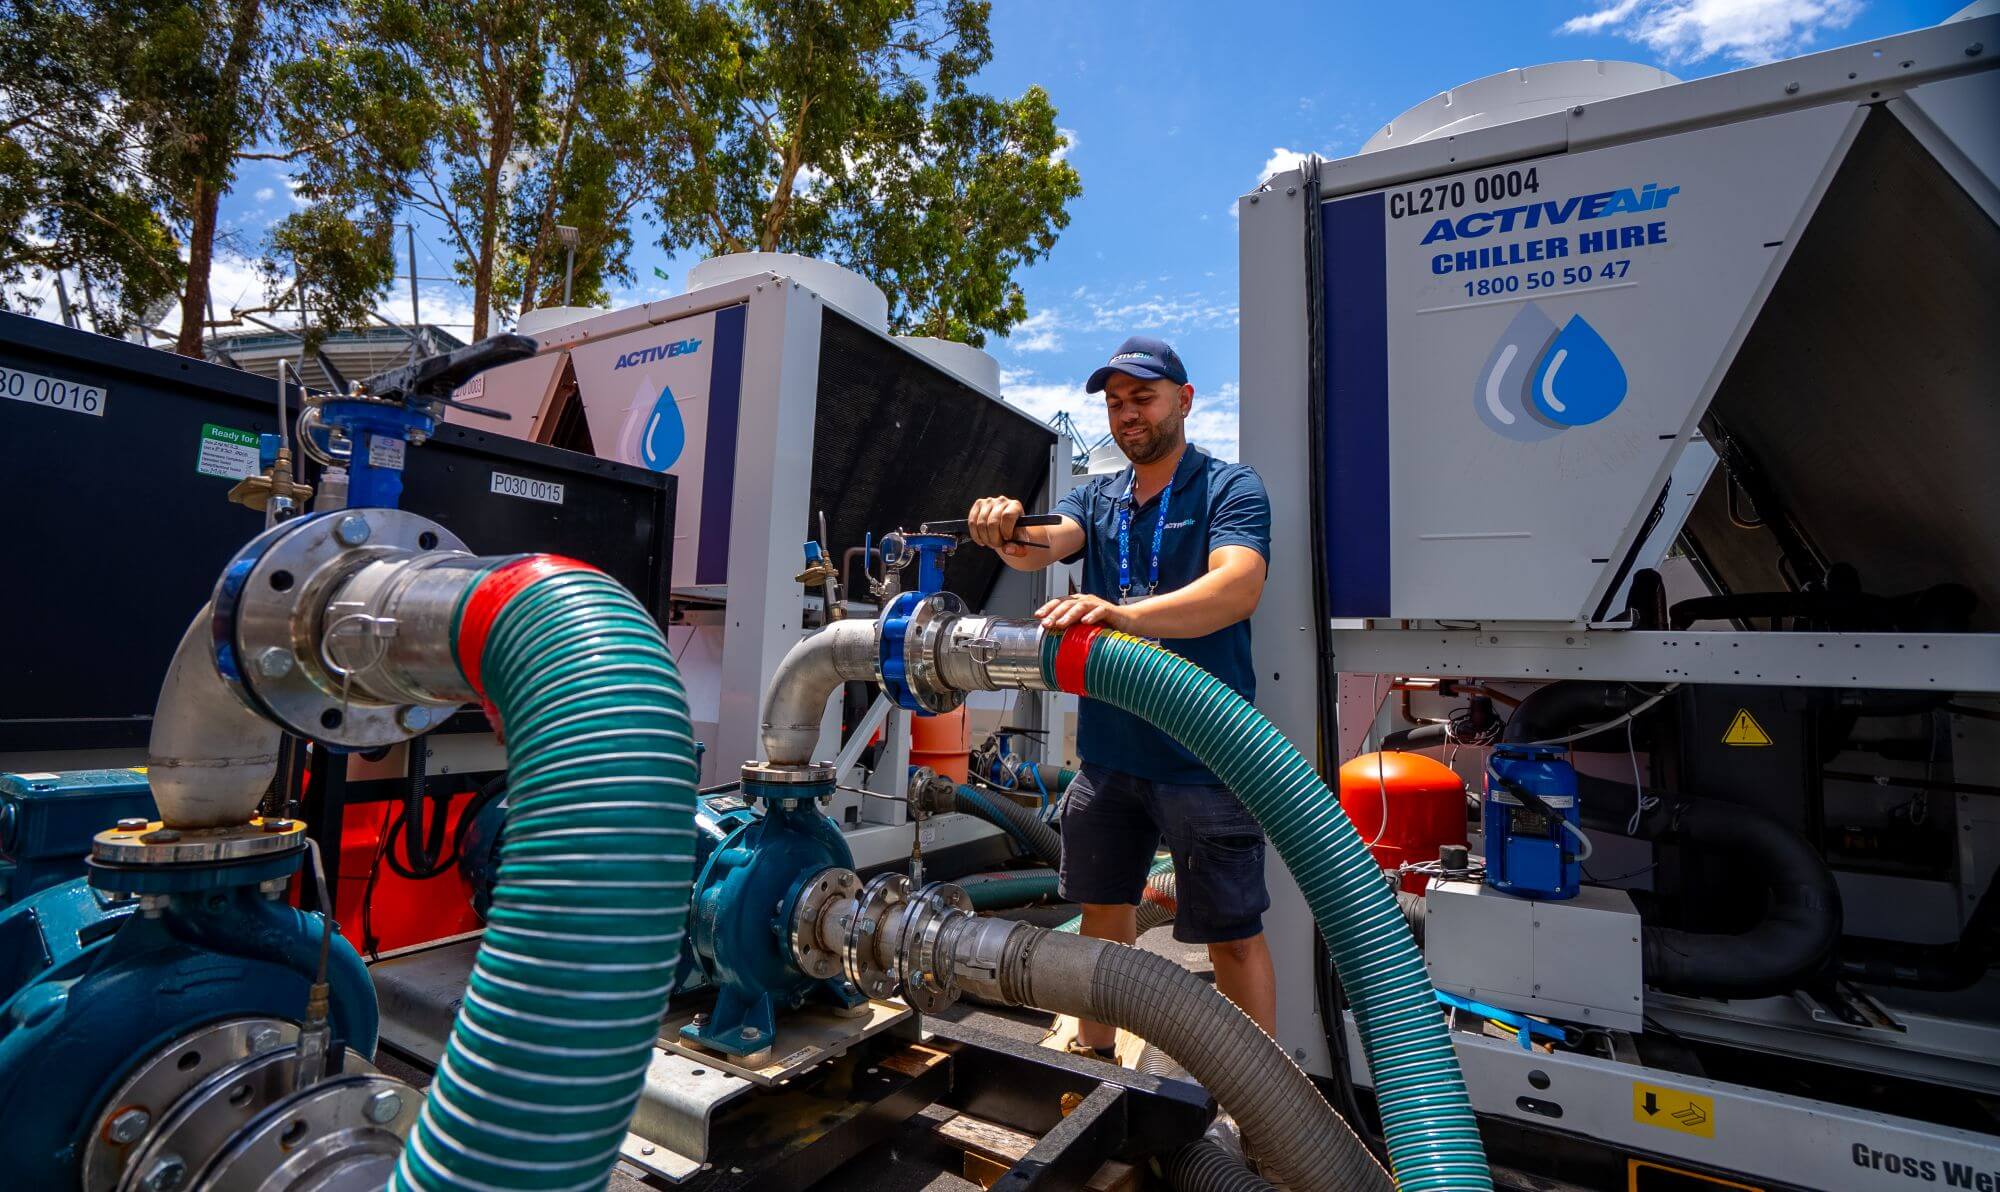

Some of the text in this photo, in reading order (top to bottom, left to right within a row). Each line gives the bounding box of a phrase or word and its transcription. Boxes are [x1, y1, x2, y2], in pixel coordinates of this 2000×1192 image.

[1390, 167, 1540, 219] CL270 0004
[1432, 221, 1668, 275] CHILLER HIRE
[1464, 259, 1631, 297] 1800 50 50 47
[34, 378, 98, 411] 0016
[212, 428, 240, 442] Ready
[242, 435, 255, 444] for
[495, 474, 560, 501] P030 0015
[1851, 1142, 1937, 1182] Gross
